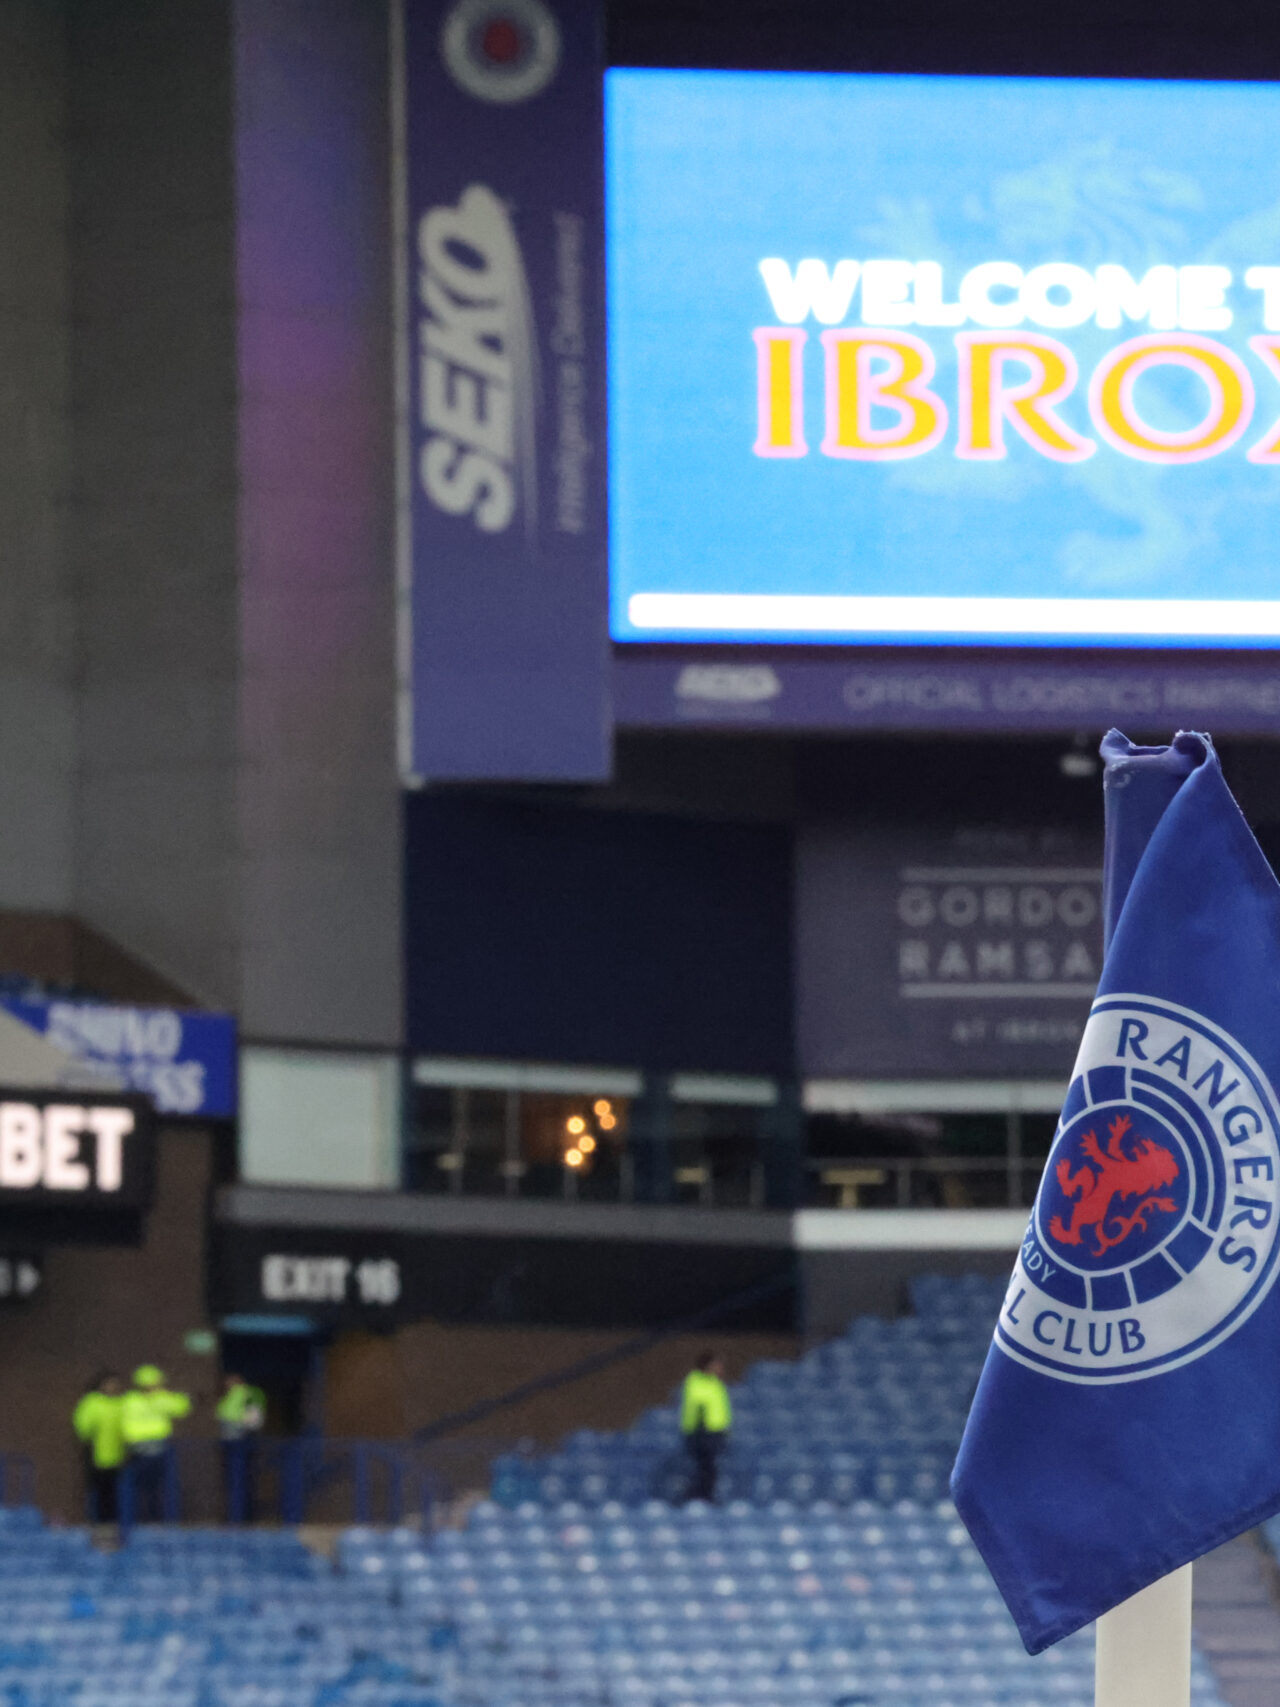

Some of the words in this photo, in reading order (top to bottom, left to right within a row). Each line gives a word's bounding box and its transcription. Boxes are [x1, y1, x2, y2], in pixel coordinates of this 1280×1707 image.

[760, 257, 1233, 330] WELCOME
[419, 183, 516, 533] SEKO
[898, 885, 1100, 928] GORDO
[898, 939, 1100, 980] RAMSA
[0, 1102, 135, 1192] BET
[1116, 1018, 1273, 1273] RANGERS
[261, 1254, 351, 1301] EXIT
[1033, 1310, 1146, 1357] CLUB
